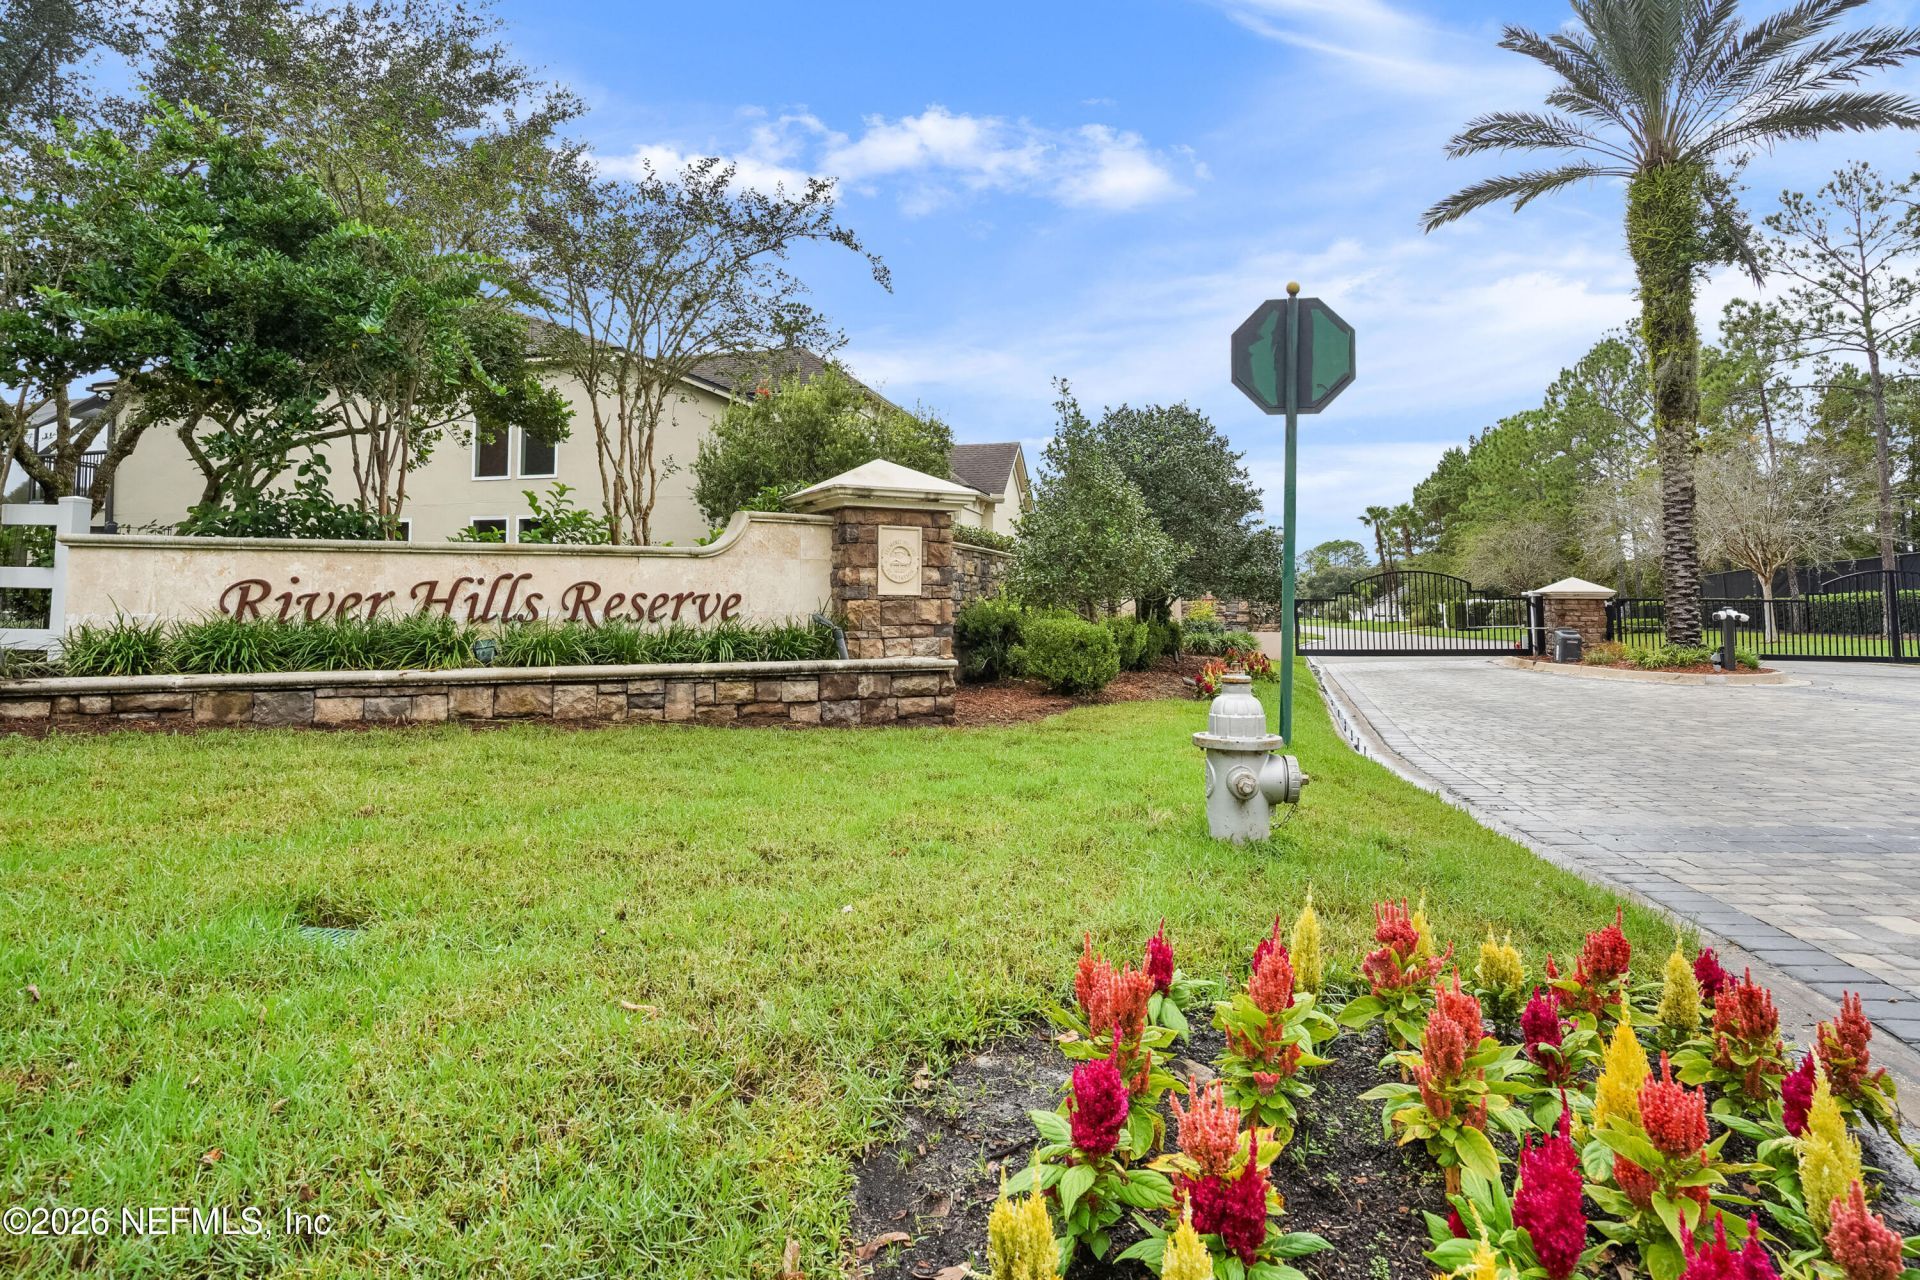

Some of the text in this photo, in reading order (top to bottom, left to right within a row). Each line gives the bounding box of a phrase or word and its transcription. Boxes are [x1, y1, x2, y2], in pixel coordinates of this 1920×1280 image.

[219, 573, 742, 627] River Hills Reserve
